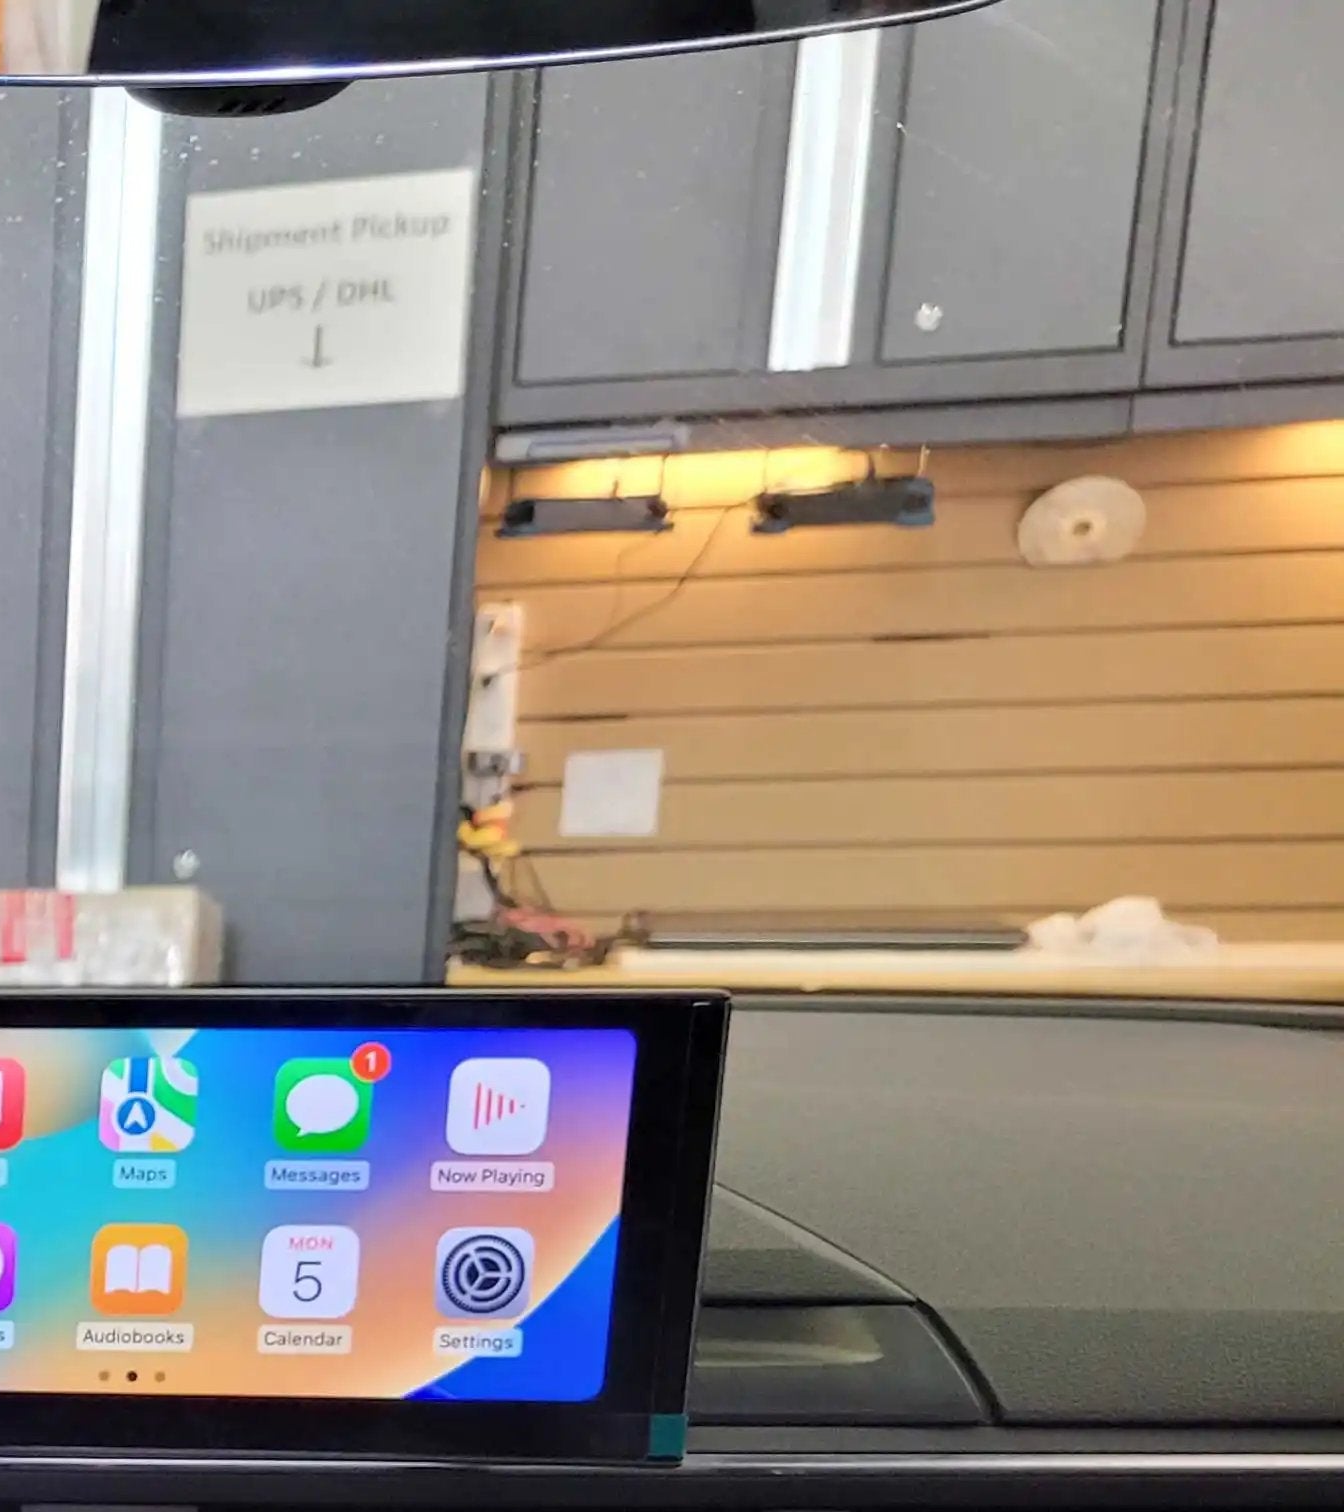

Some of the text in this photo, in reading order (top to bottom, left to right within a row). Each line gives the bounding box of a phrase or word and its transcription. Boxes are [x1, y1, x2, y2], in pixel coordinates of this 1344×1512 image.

[202, 212, 450, 256] Shipment Pickup
[246, 284, 305, 314] UPS
[336, 278, 394, 307] DHL
[364, 1051, 378, 1072] 1
[119, 1165, 168, 1183] Maps
[272, 1167, 361, 1187] Messages
[438, 1169, 545, 1188] Now Playing
[288, 1237, 334, 1251] MON
[291, 1260, 323, 1303] 5
[82, 1328, 185, 1346] Audiobooks
[264, 1331, 343, 1348] Calendar
[439, 1333, 514, 1352] Settings
